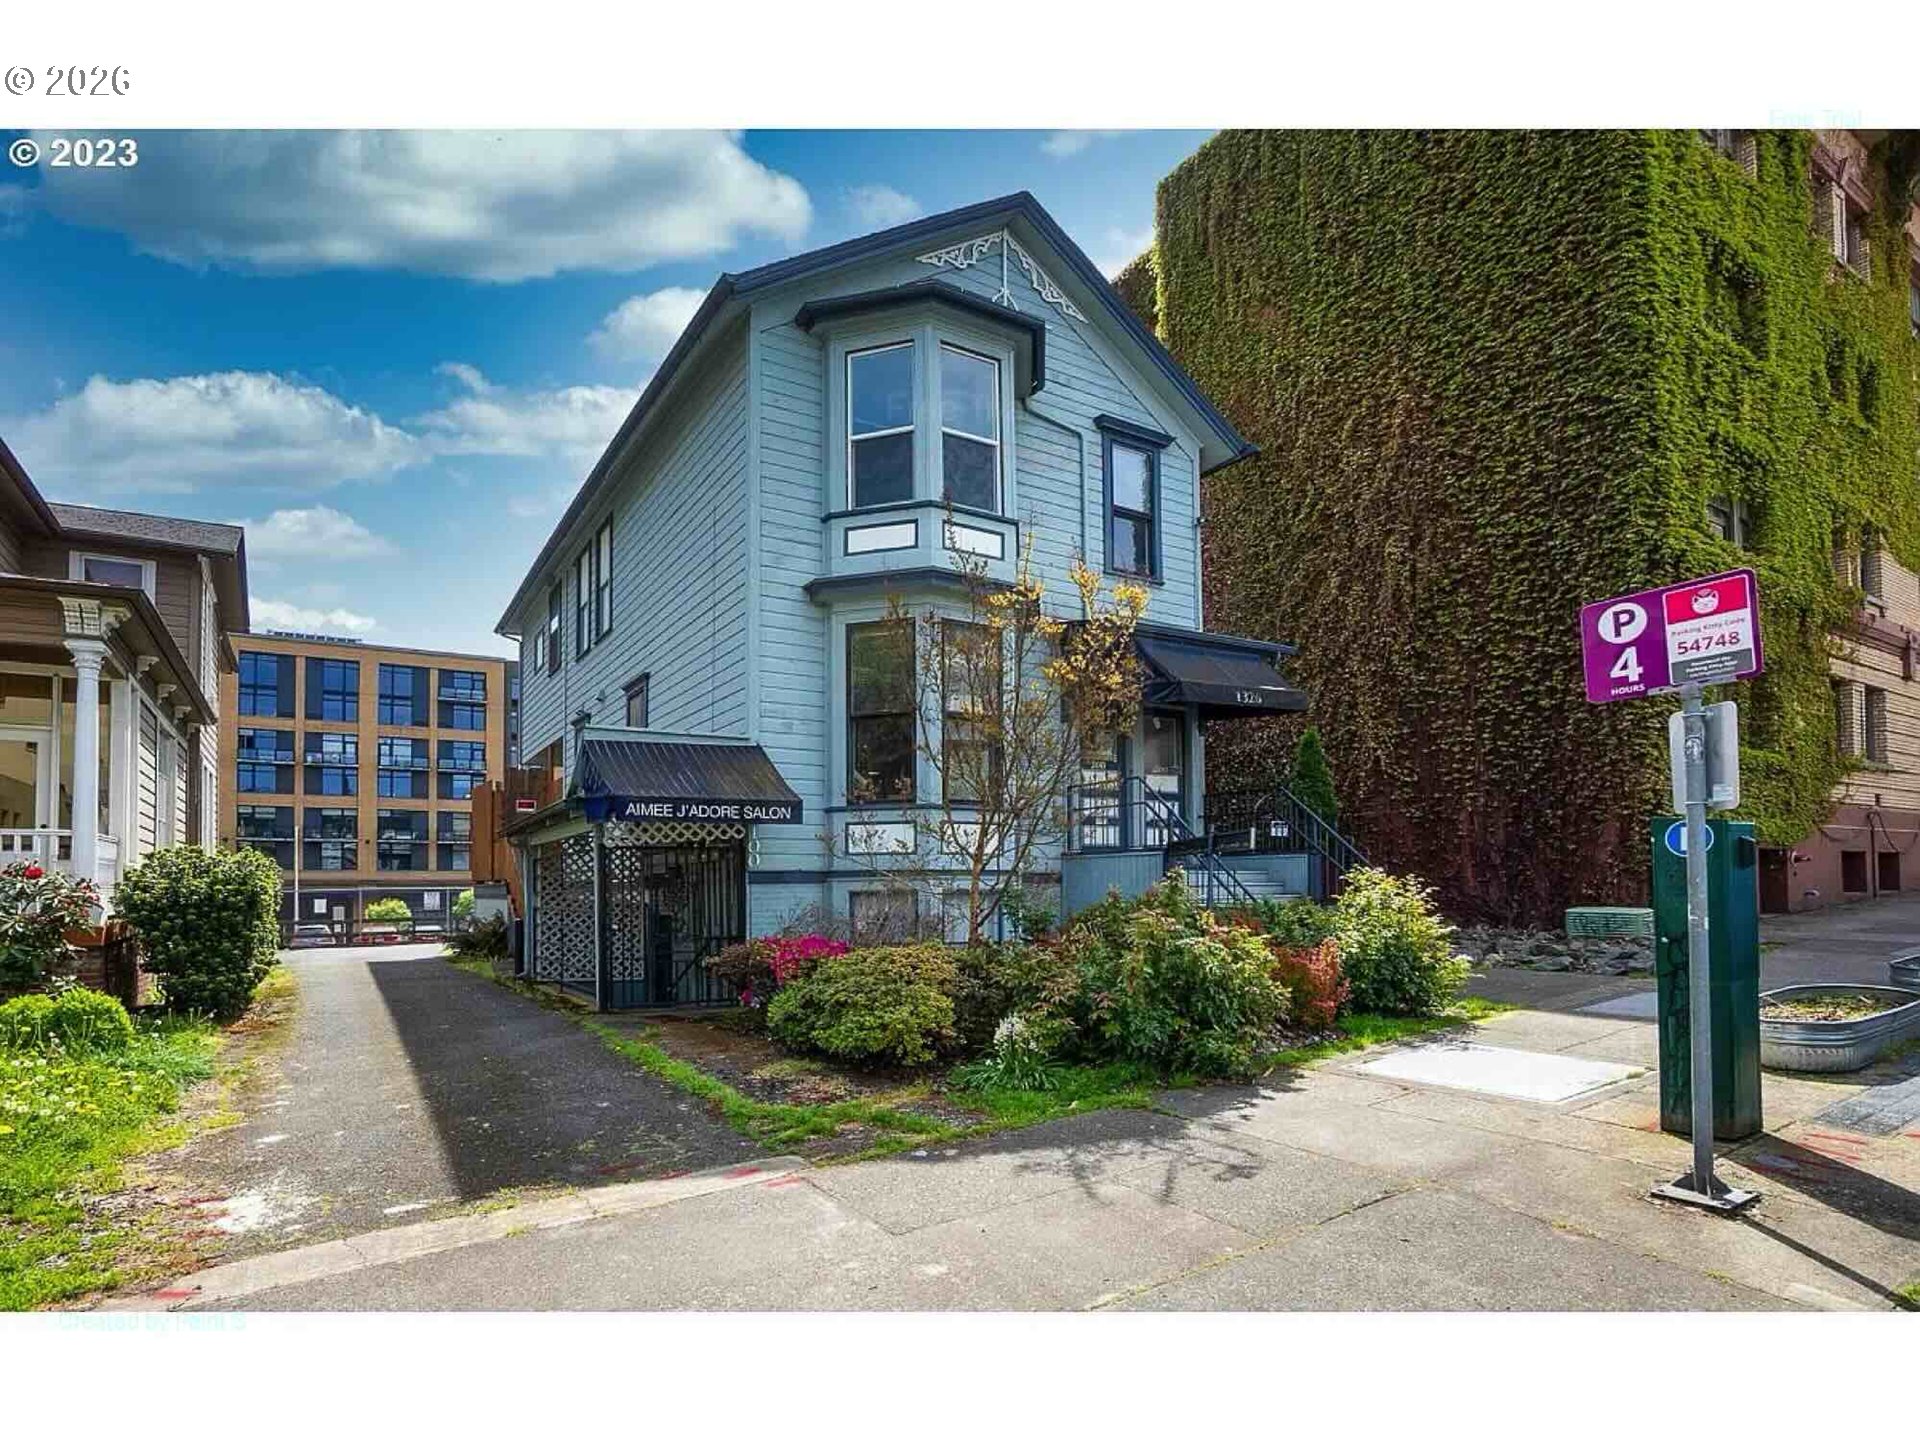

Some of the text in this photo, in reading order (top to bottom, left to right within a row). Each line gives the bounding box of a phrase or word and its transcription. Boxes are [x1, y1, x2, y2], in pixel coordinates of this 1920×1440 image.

[1613, 609, 1635, 638] P
[1677, 631, 1741, 655] 54748
[1610, 646, 1643, 683] 4
[1611, 683, 1646, 696] HOURS
[625, 803, 792, 819] AIMEE J'ADORE SALON
